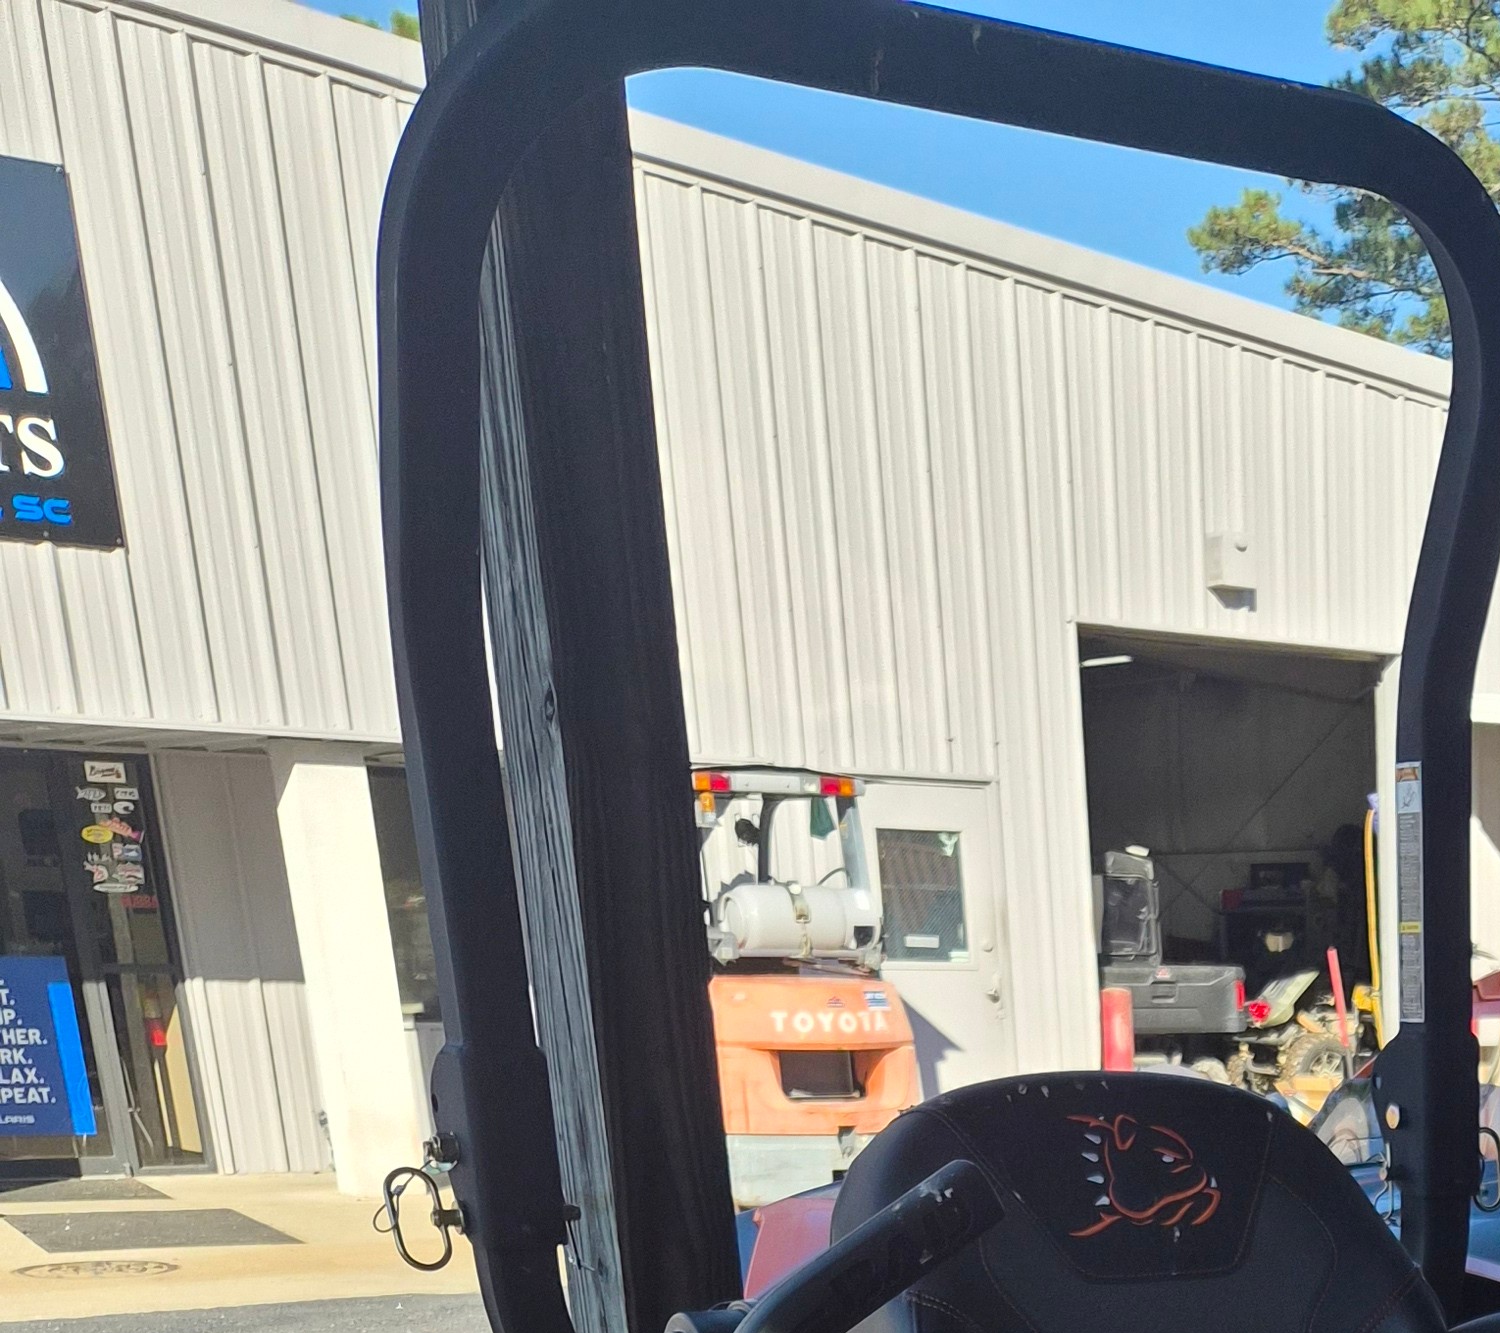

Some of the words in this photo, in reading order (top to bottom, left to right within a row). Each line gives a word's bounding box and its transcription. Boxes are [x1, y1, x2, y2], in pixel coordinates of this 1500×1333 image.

[12, 494, 72, 525] SC
[0, 1007, 23, 1026] P.
[770, 1010, 888, 1033] TOYOTA
[0, 1027, 48, 1045] HER.
